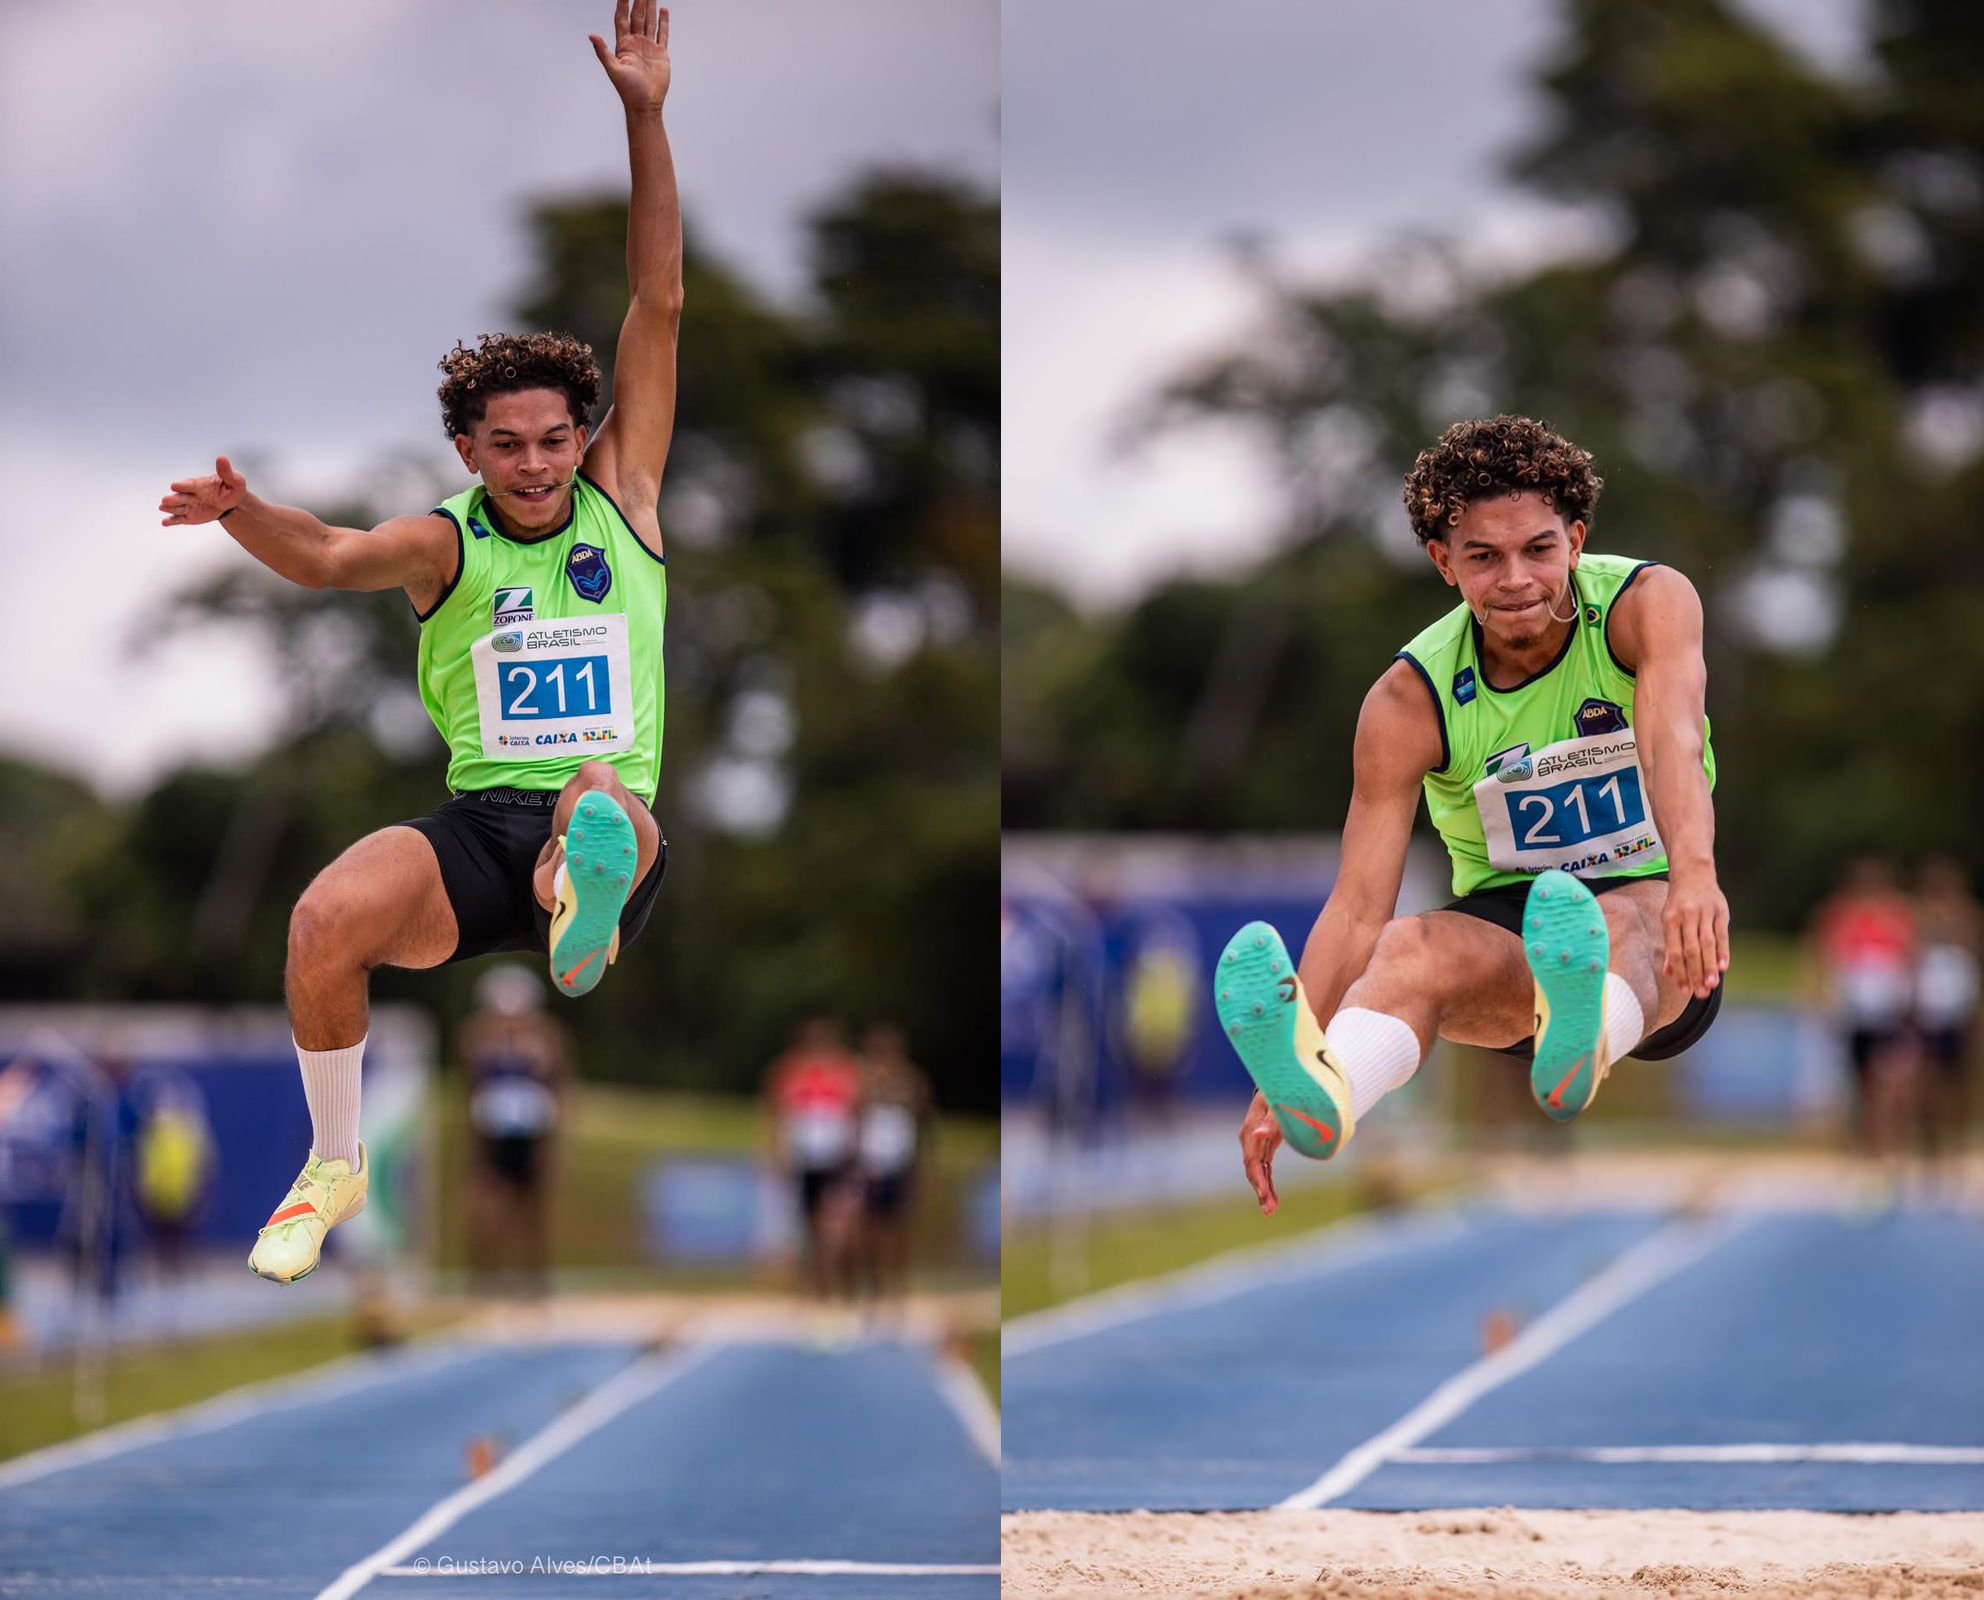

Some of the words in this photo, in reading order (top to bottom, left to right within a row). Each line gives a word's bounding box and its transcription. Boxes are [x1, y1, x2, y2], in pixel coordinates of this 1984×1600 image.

[572, 549, 593, 564] ABDA
[527, 626, 607, 641] ATLETISMO
[527, 638, 581, 649] BRASIL
[508, 661, 596, 715] 211
[1582, 706, 1607, 719] ABDA
[535, 732, 578, 745] CAIXA
[1537, 741, 1636, 767] ATLETISMO
[1537, 756, 1603, 777] BRASIL
[480, 787, 546, 806] NIKE
[1519, 775, 1626, 844] 211
[1560, 852, 1609, 873] CAIXA
